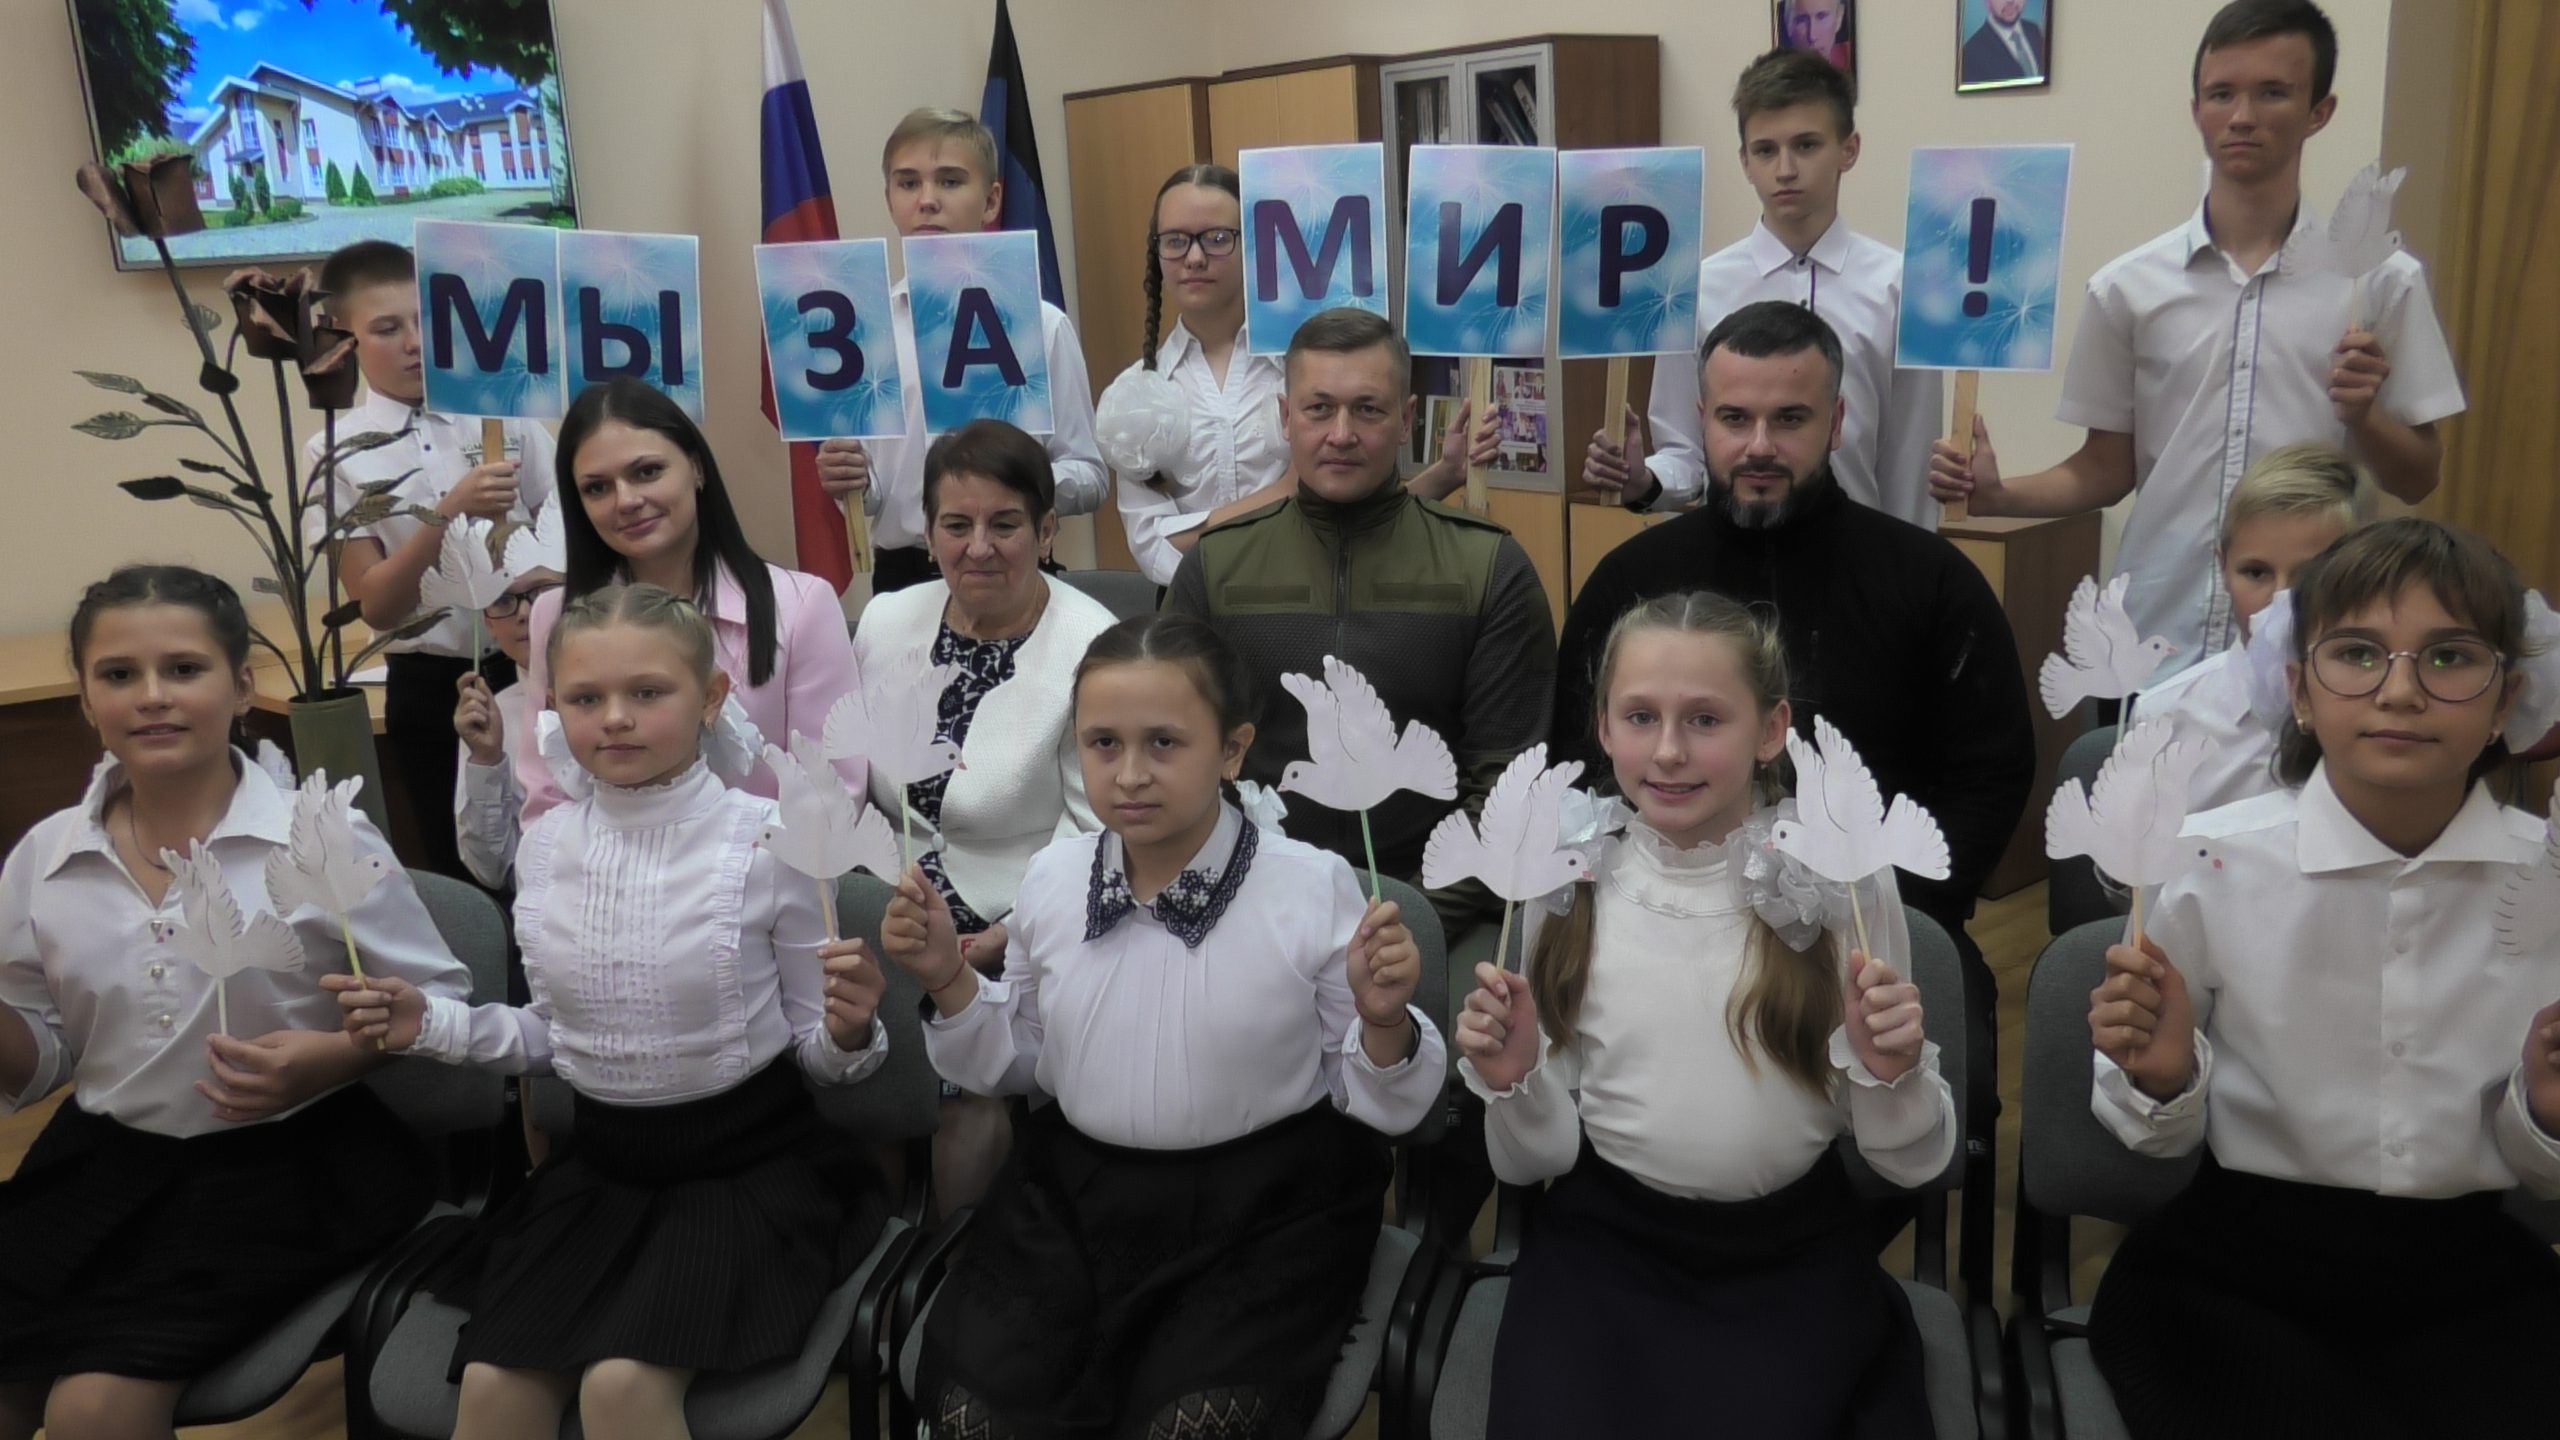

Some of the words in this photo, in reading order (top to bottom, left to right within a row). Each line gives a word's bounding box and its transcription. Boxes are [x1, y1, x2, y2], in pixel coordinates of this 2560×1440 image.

[429, 272, 685, 386] МЫ
[797, 288, 1027, 392] ЗА
[1254, 195, 1671, 309] МИР
